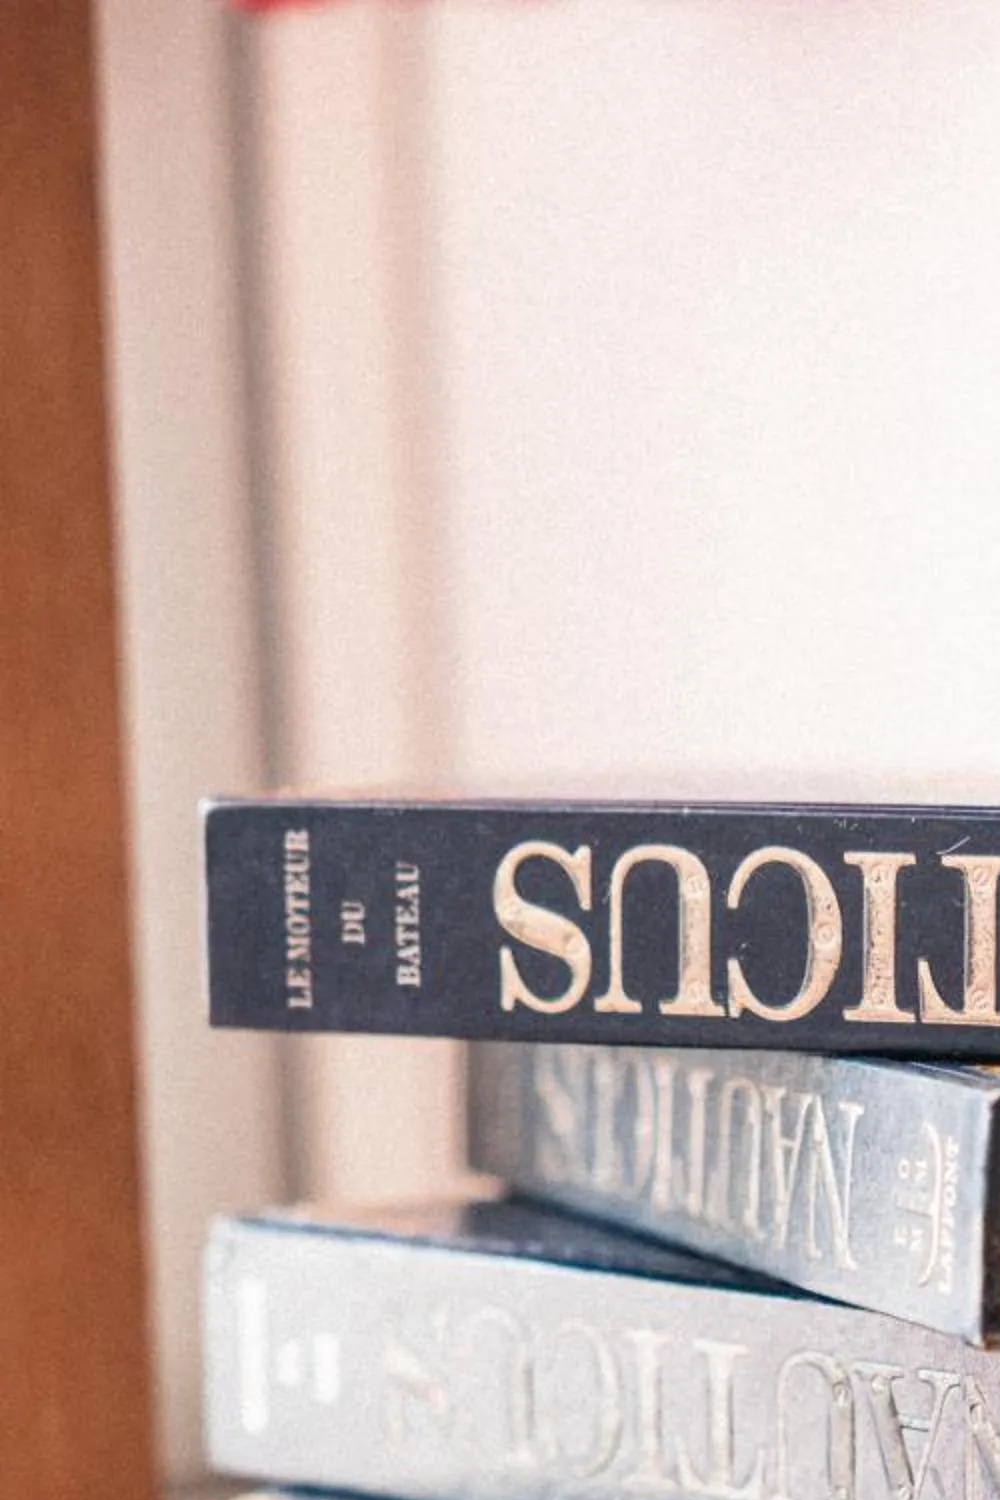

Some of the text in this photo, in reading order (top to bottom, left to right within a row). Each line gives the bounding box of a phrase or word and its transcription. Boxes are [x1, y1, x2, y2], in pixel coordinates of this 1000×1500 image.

[284, 829, 312, 1009] LE MOTEUR
[340, 901, 365, 944] DU
[395, 862, 421, 988] BATEAU
